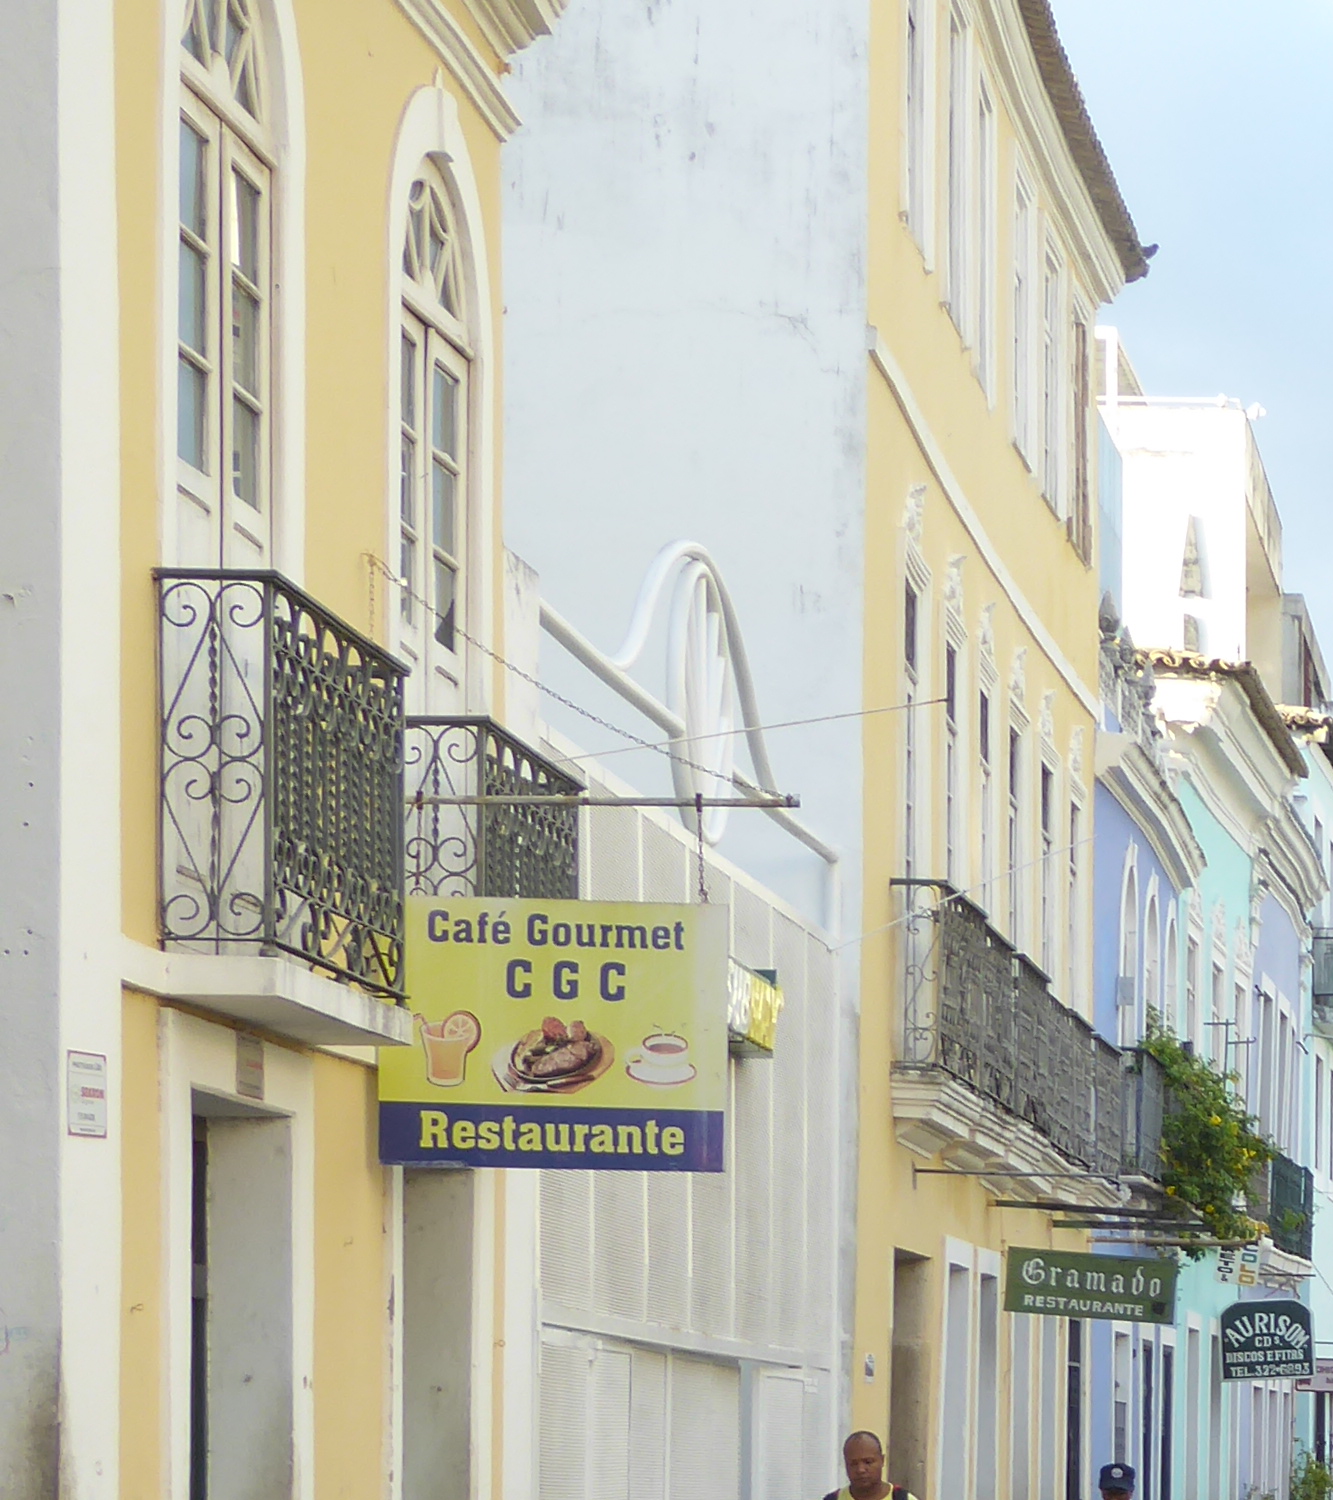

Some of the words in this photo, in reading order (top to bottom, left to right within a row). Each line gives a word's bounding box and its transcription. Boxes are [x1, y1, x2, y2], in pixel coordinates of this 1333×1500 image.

[427, 909, 511, 944] Café
[526, 912, 686, 951] Gourmet
[505, 957, 532, 998] C
[552, 959, 580, 1000] G
[600, 961, 627, 1001] C
[419, 1109, 685, 1156] Restaurante
[1021, 1257, 1161, 1298] Gramado
[1023, 1294, 1144, 1317] RESTAURANTE
[1225, 1350, 1265, 1364] DISCOS
